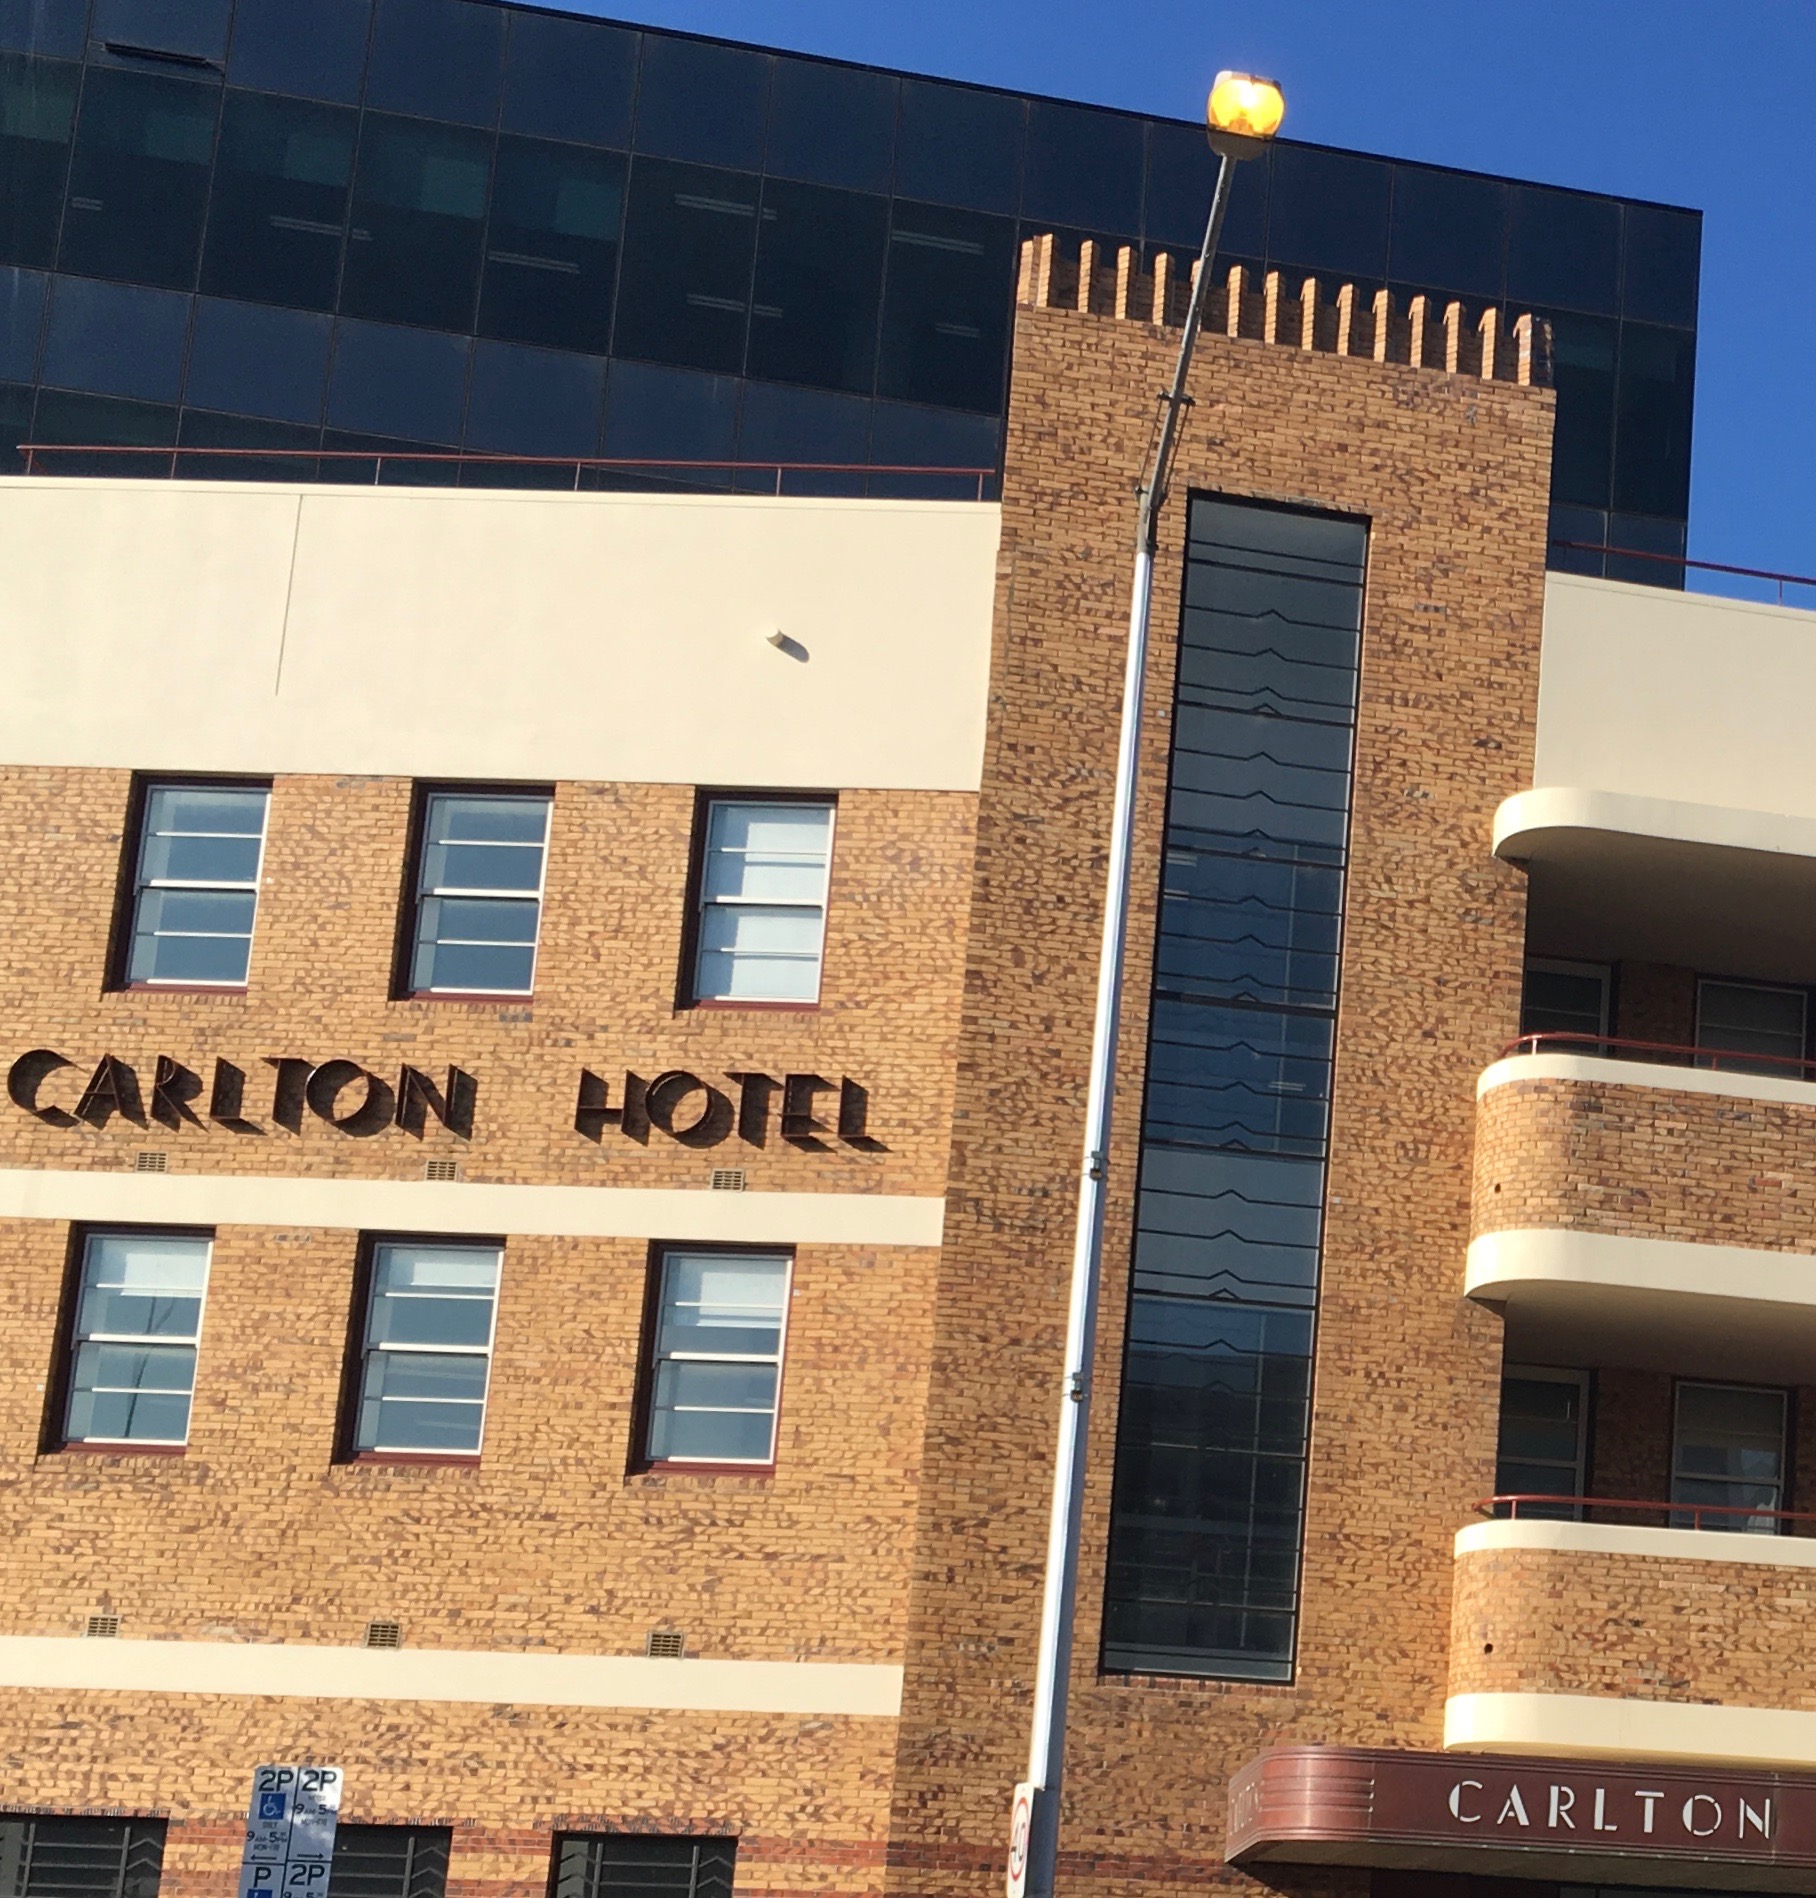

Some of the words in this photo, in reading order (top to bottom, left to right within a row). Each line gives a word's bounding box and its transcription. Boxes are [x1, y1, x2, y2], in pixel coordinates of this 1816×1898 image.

[7, 1048, 479, 1143] CARLTON
[574, 1067, 892, 1153] HOTEL
[258, 1769, 294, 1792] 2P
[301, 1769, 337, 1792] 2P
[1448, 1780, 1771, 1840] CARLTON
[253, 1866, 272, 1888] P
[289, 1863, 325, 1886] 2P
